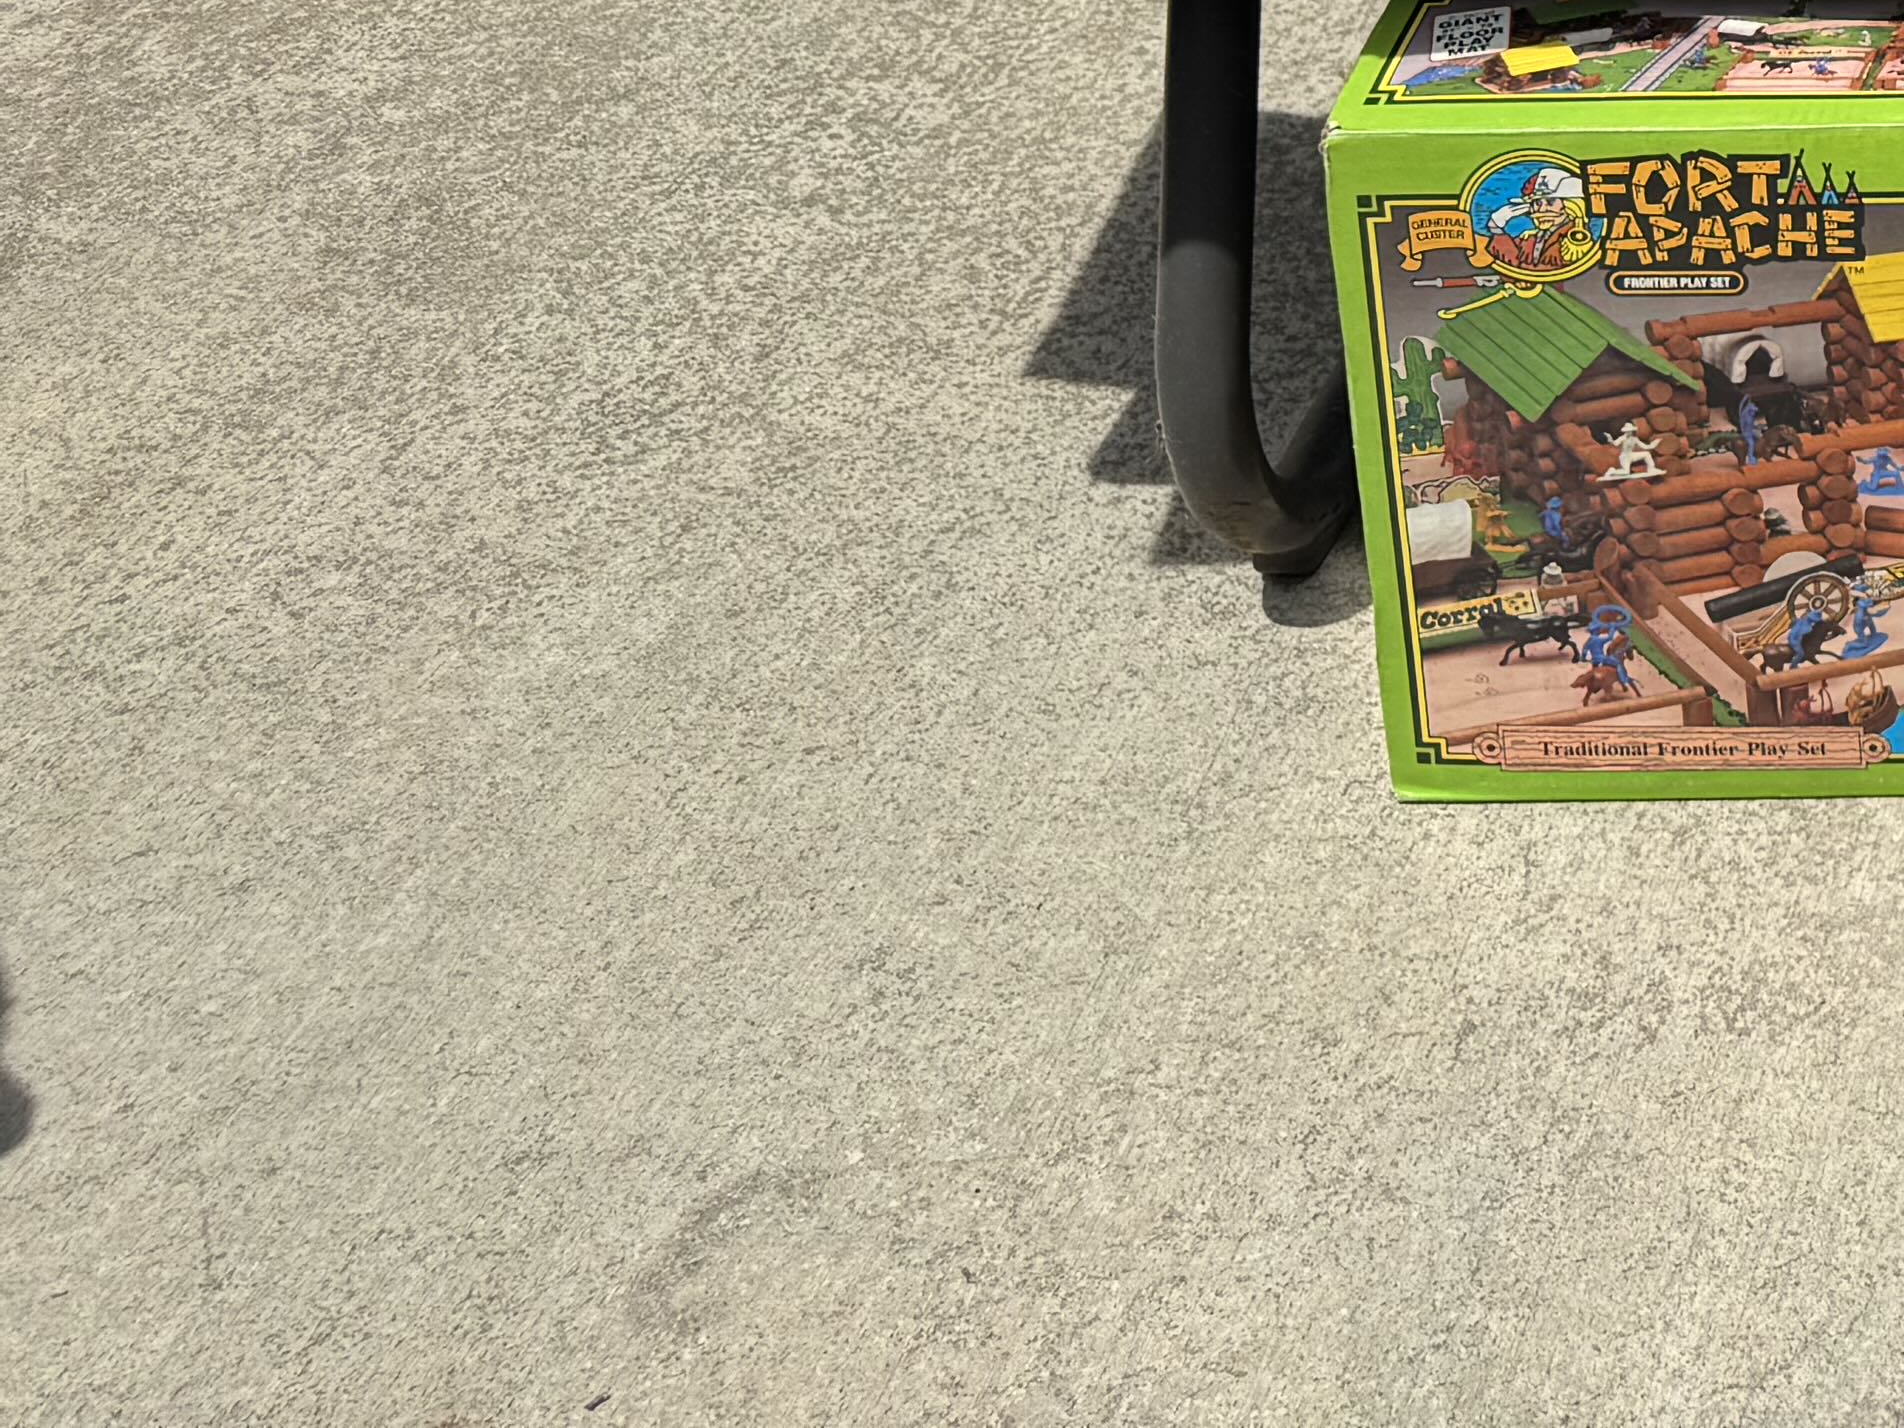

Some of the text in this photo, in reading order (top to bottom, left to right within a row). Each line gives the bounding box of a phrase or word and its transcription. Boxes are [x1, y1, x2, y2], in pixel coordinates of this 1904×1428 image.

[1438, 14, 1504, 29] GIANT
[1436, 26, 1504, 42] FLOOR
[1443, 34, 1495, 49] PLAY
[1447, 44, 1490, 56] MAT
[1586, 157, 1781, 215] FORT
[1411, 216, 1469, 231] GENERAL
[1416, 228, 1466, 242] CUSTER
[1602, 209, 1857, 266] APACHE
[1848, 266, 1865, 275] TM
[1623, 275, 1731, 289] FRONTIER PLAY SET
[1420, 597, 1502, 629] Corral
[1538, 741, 1827, 759] Traditional Frontier Play Set
